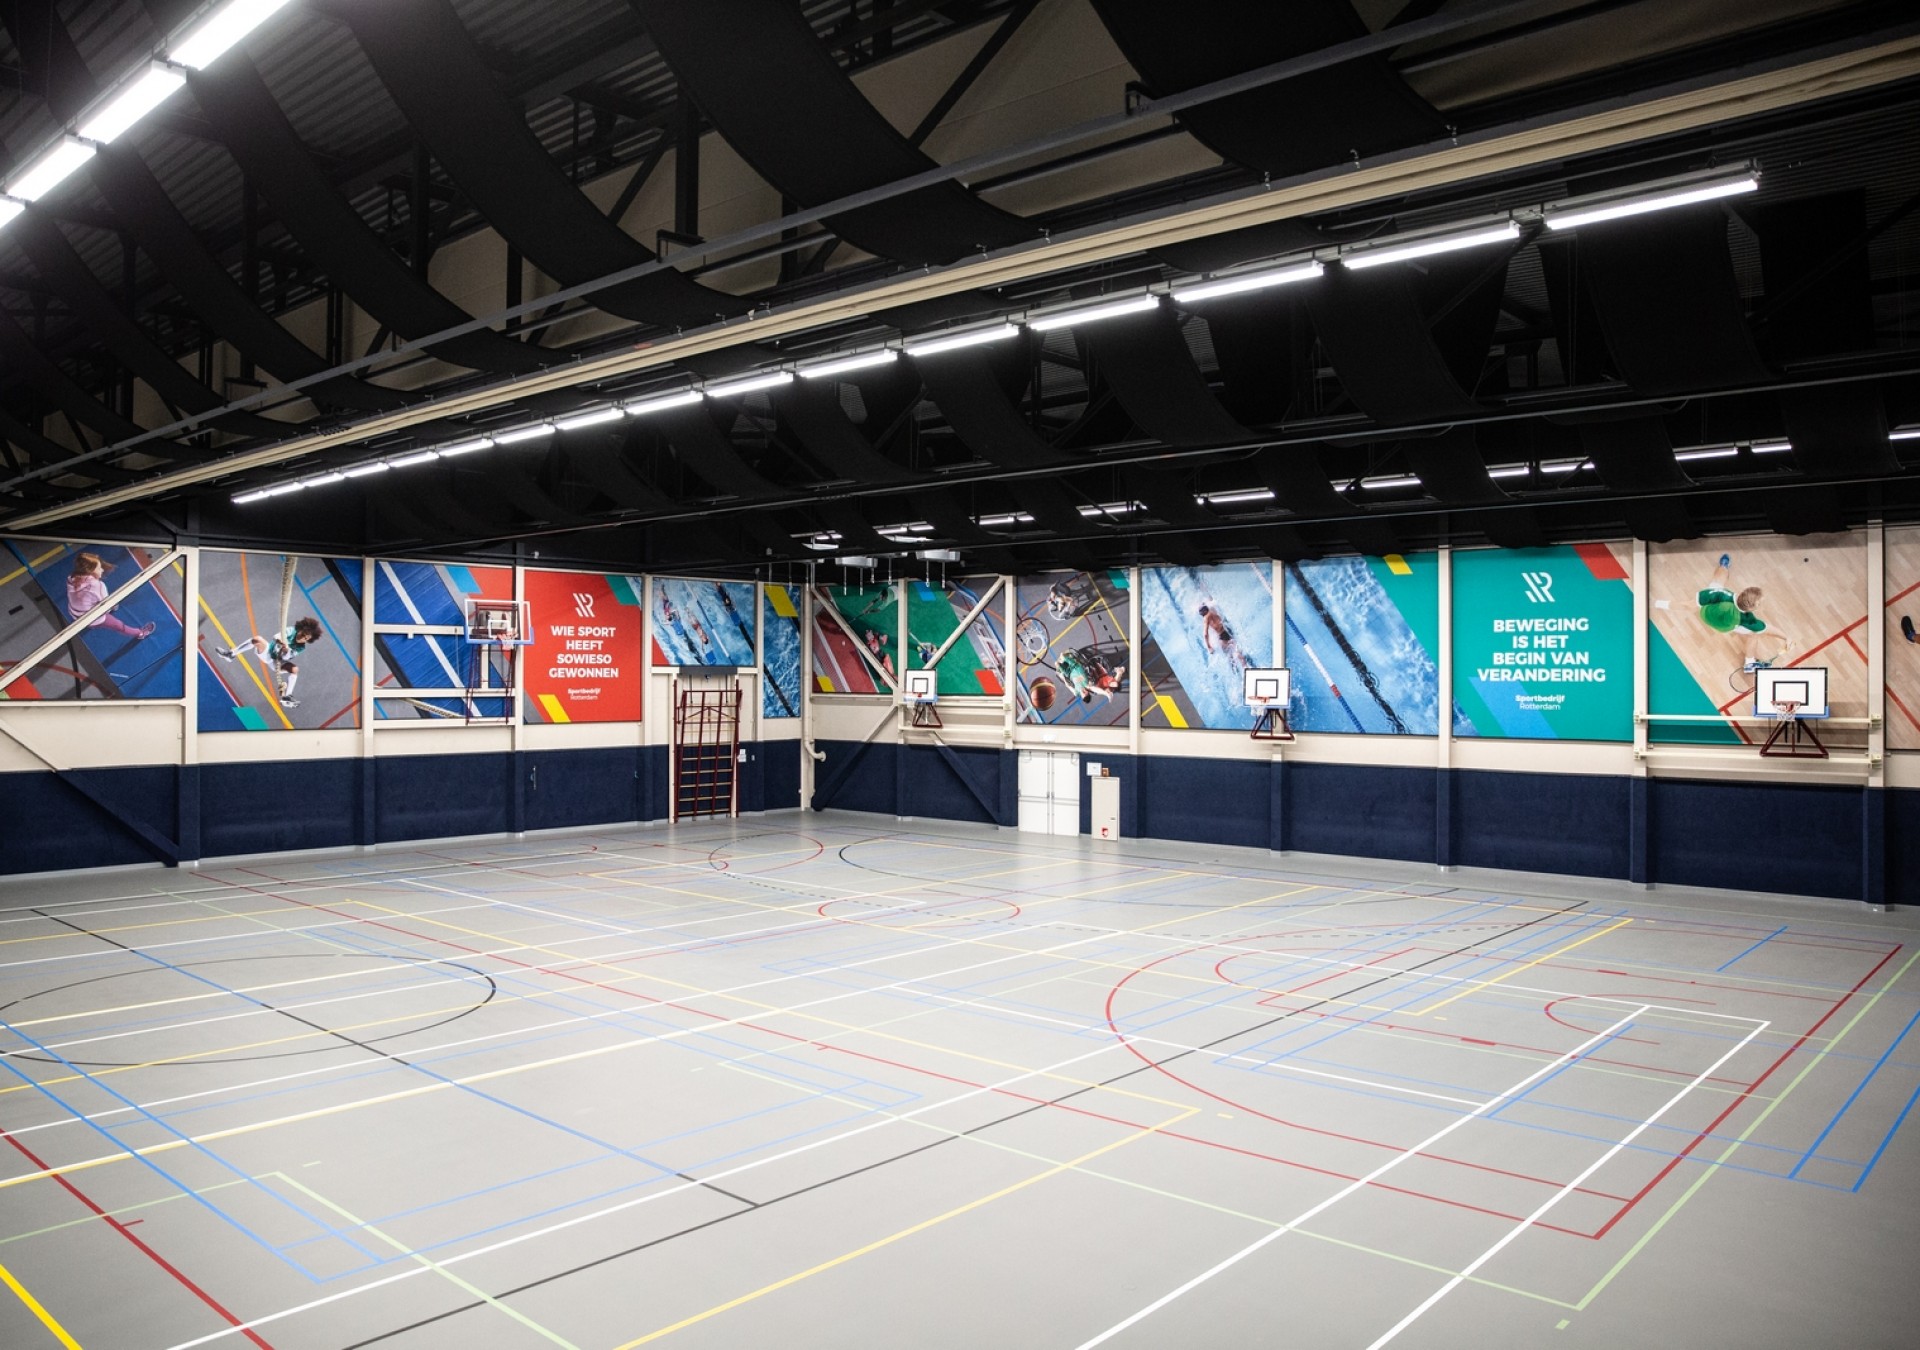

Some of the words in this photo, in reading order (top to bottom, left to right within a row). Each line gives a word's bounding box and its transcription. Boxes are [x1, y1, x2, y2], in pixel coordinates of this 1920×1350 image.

[1493, 617, 1589, 632] BEWEGING
[551, 625, 575, 637] WIE
[578, 626, 616, 638] SPORT
[566, 639, 604, 651] HEEFT
[1512, 635, 1529, 649] IS
[1533, 635, 1569, 649] HET
[556, 653, 612, 665] SOWIESO
[1493, 652, 1546, 665] BEGIN
[1551, 651, 1589, 665] VAN
[548, 667, 620, 679] GEWONNEN
[1477, 668, 1606, 682] VERANDERING
[568, 687, 601, 695] Sportbedrijf
[1514, 694, 1566, 703] Sportbedrijf
[1519, 702, 1561, 710] Rotterdam
